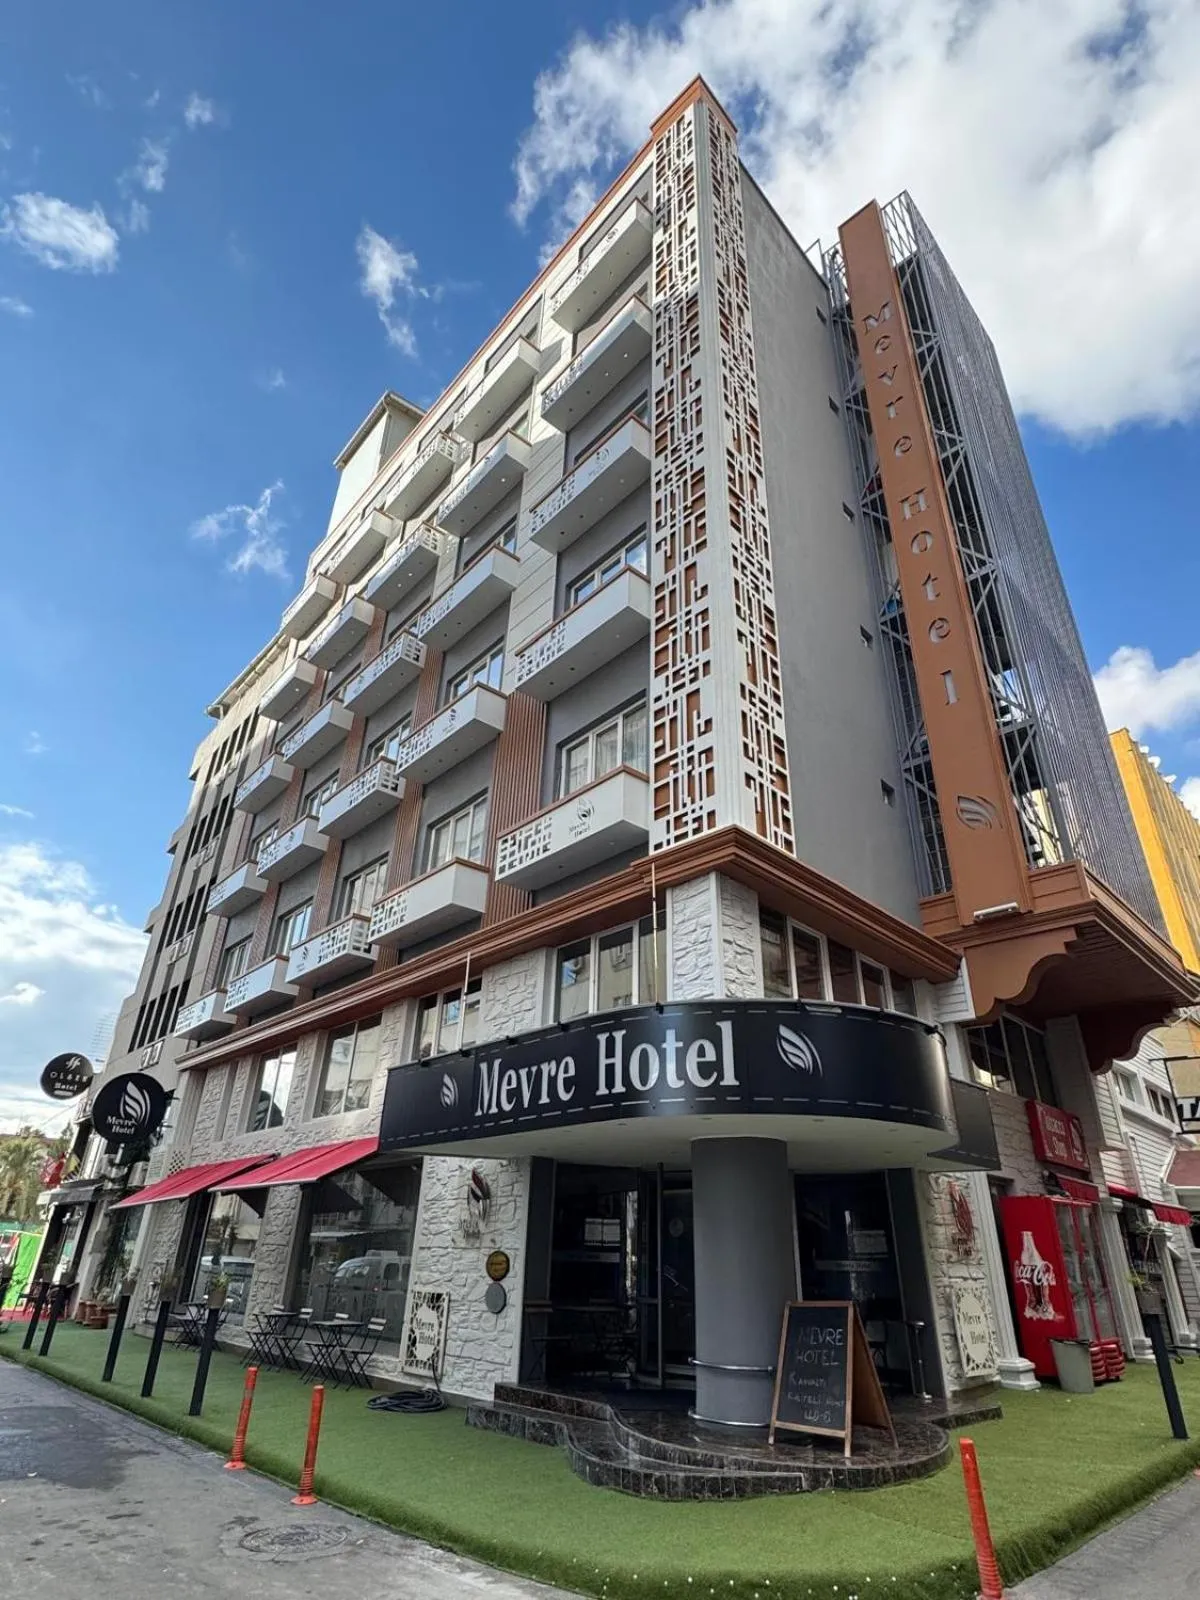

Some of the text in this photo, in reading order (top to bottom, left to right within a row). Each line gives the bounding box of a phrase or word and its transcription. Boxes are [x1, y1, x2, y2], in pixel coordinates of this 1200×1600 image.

[861, 301, 960, 707] Mevre Hotel
[474, 1020, 740, 1117] Mevre Hotel
[54, 1082, 78, 1091] Hotel
[106, 1115, 136, 1127] Mevre
[111, 1124, 136, 1136] Hotel
[962, 1312, 981, 1326] Mevre
[969, 1330, 987, 1345] Hotel
[796, 1349, 841, 1366] HOTEL
